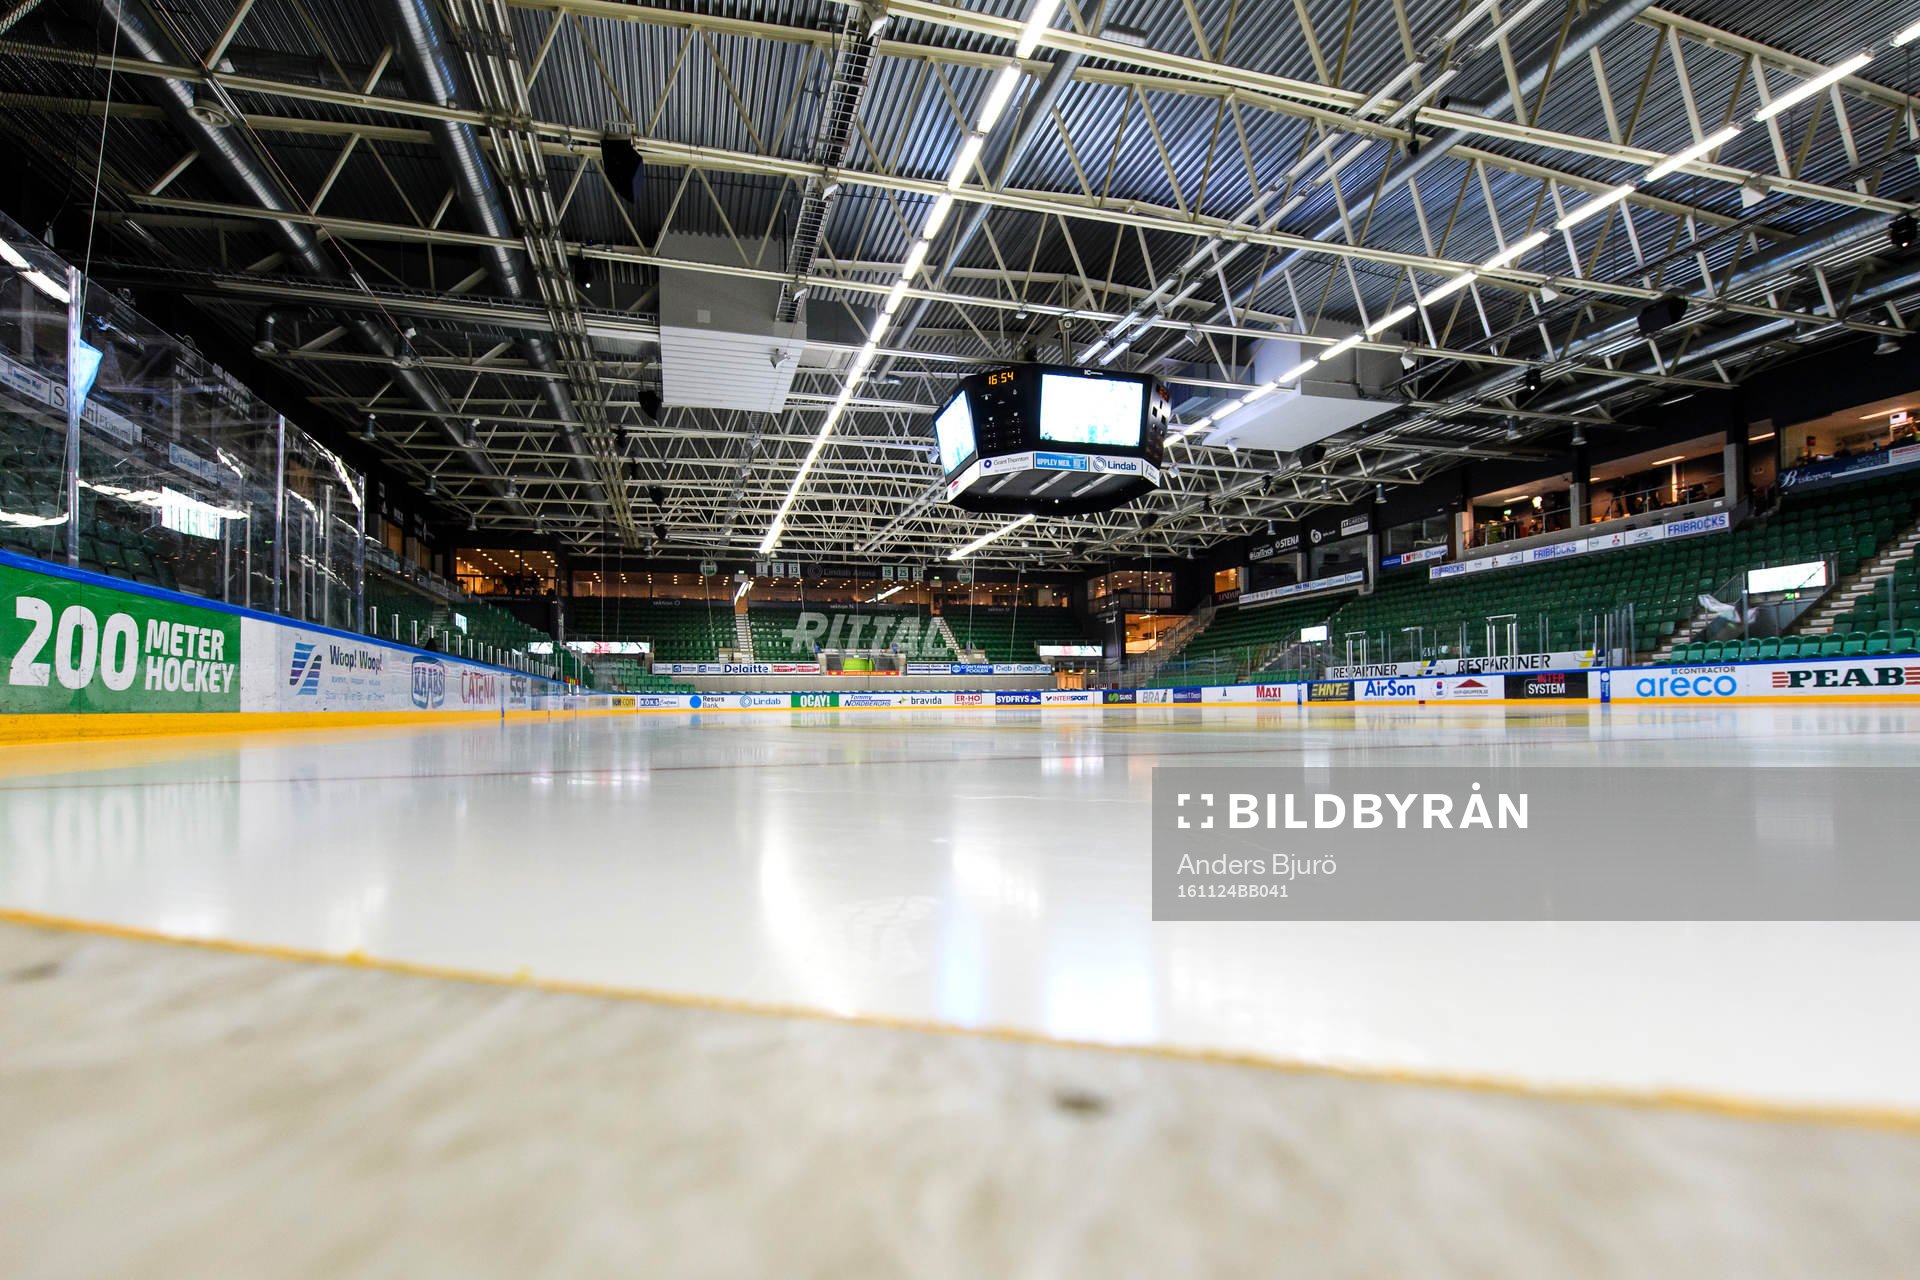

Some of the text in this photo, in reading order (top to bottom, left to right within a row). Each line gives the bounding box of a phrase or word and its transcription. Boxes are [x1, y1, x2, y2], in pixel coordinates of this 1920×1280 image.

[1007, 455, 1029, 465] Thornton
[1107, 459, 1136, 471] Lindab
[1667, 516, 1726, 537] FRIBROCKS
[1280, 534, 1299, 548] STENA
[1533, 544, 1577, 560] FRIBROCKS
[145, 619, 225, 661] METER
[781, 611, 955, 657] RITTAL
[8, 596, 139, 691] 200
[329, 645, 357, 672] Woop!
[144, 655, 235, 693] HOCKEY
[1678, 666, 1736, 675] CONTRACTOR
[1787, 667, 1905, 688] PEAB
[1536, 673, 1566, 684] INTER
[461, 671, 496, 704] CATENA
[1364, 680, 1416, 697] AirSon
[1528, 683, 1566, 695] SYSTEM
[1636, 675, 1737, 697] areco
[753, 697, 781, 705] Lindab
[800, 695, 831, 707] OCAY!
[911, 696, 942, 705] bravida
[996, 694, 1030, 704] SYDFRYS
[1052, 694, 1089, 702] INTERSPORT
[1143, 691, 1160, 703] BRA
